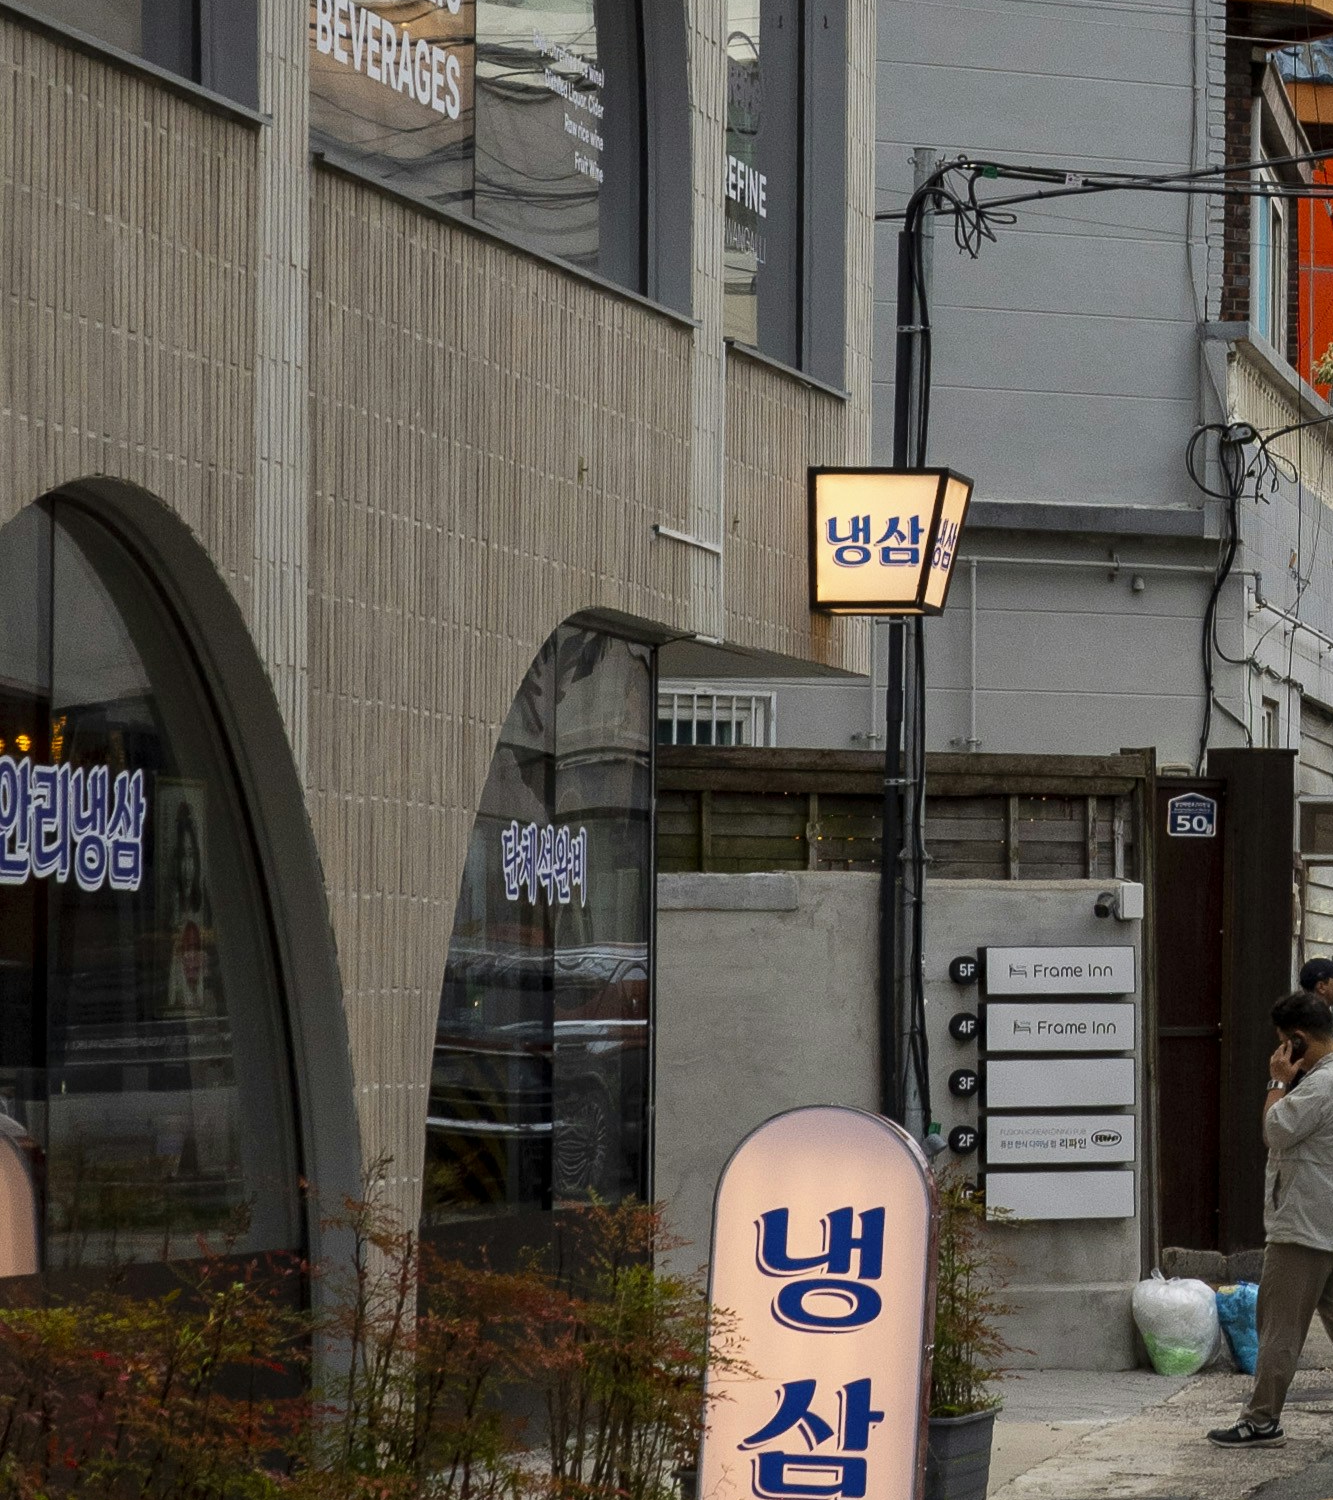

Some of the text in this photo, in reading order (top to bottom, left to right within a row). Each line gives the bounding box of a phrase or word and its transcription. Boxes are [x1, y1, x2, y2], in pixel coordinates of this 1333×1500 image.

[824, 513, 925, 569] 냉삼
[1176, 815, 1208, 832] 50
[959, 963, 975, 977] 5F
[1033, 964, 1113, 978] Frame Inn
[958, 1021, 975, 1034] 4F
[1037, 1021, 1117, 1035] Frame Inn
[958, 1077, 975, 1091] 3F
[958, 1133, 975, 1148] 2F
[1059, 1138, 1087, 1150] 리파인
